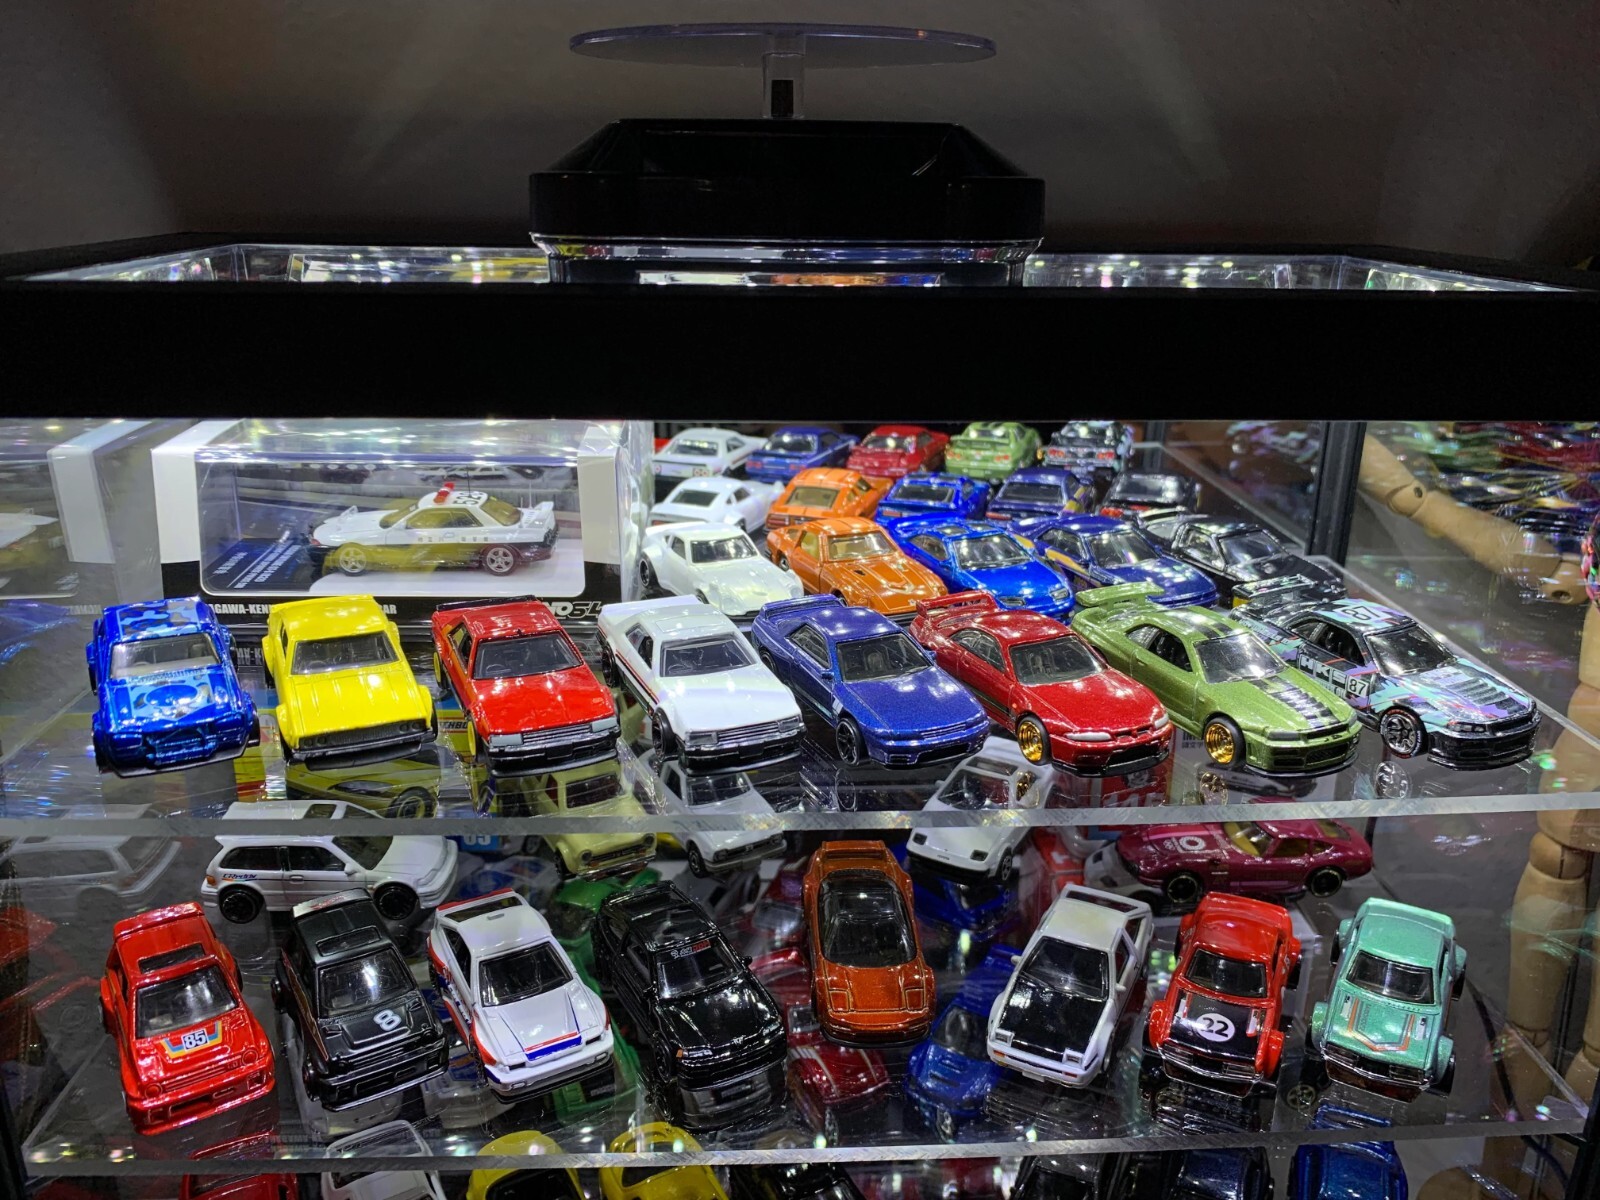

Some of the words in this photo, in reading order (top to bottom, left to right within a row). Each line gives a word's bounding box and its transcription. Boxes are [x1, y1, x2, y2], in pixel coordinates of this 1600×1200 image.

[1342, 605, 1380, 621] 87
[1350, 678, 1367, 695] 87
[373, 1009, 402, 1031] 8
[1201, 1017, 1229, 1038] 22
[184, 1030, 207, 1049] 85
